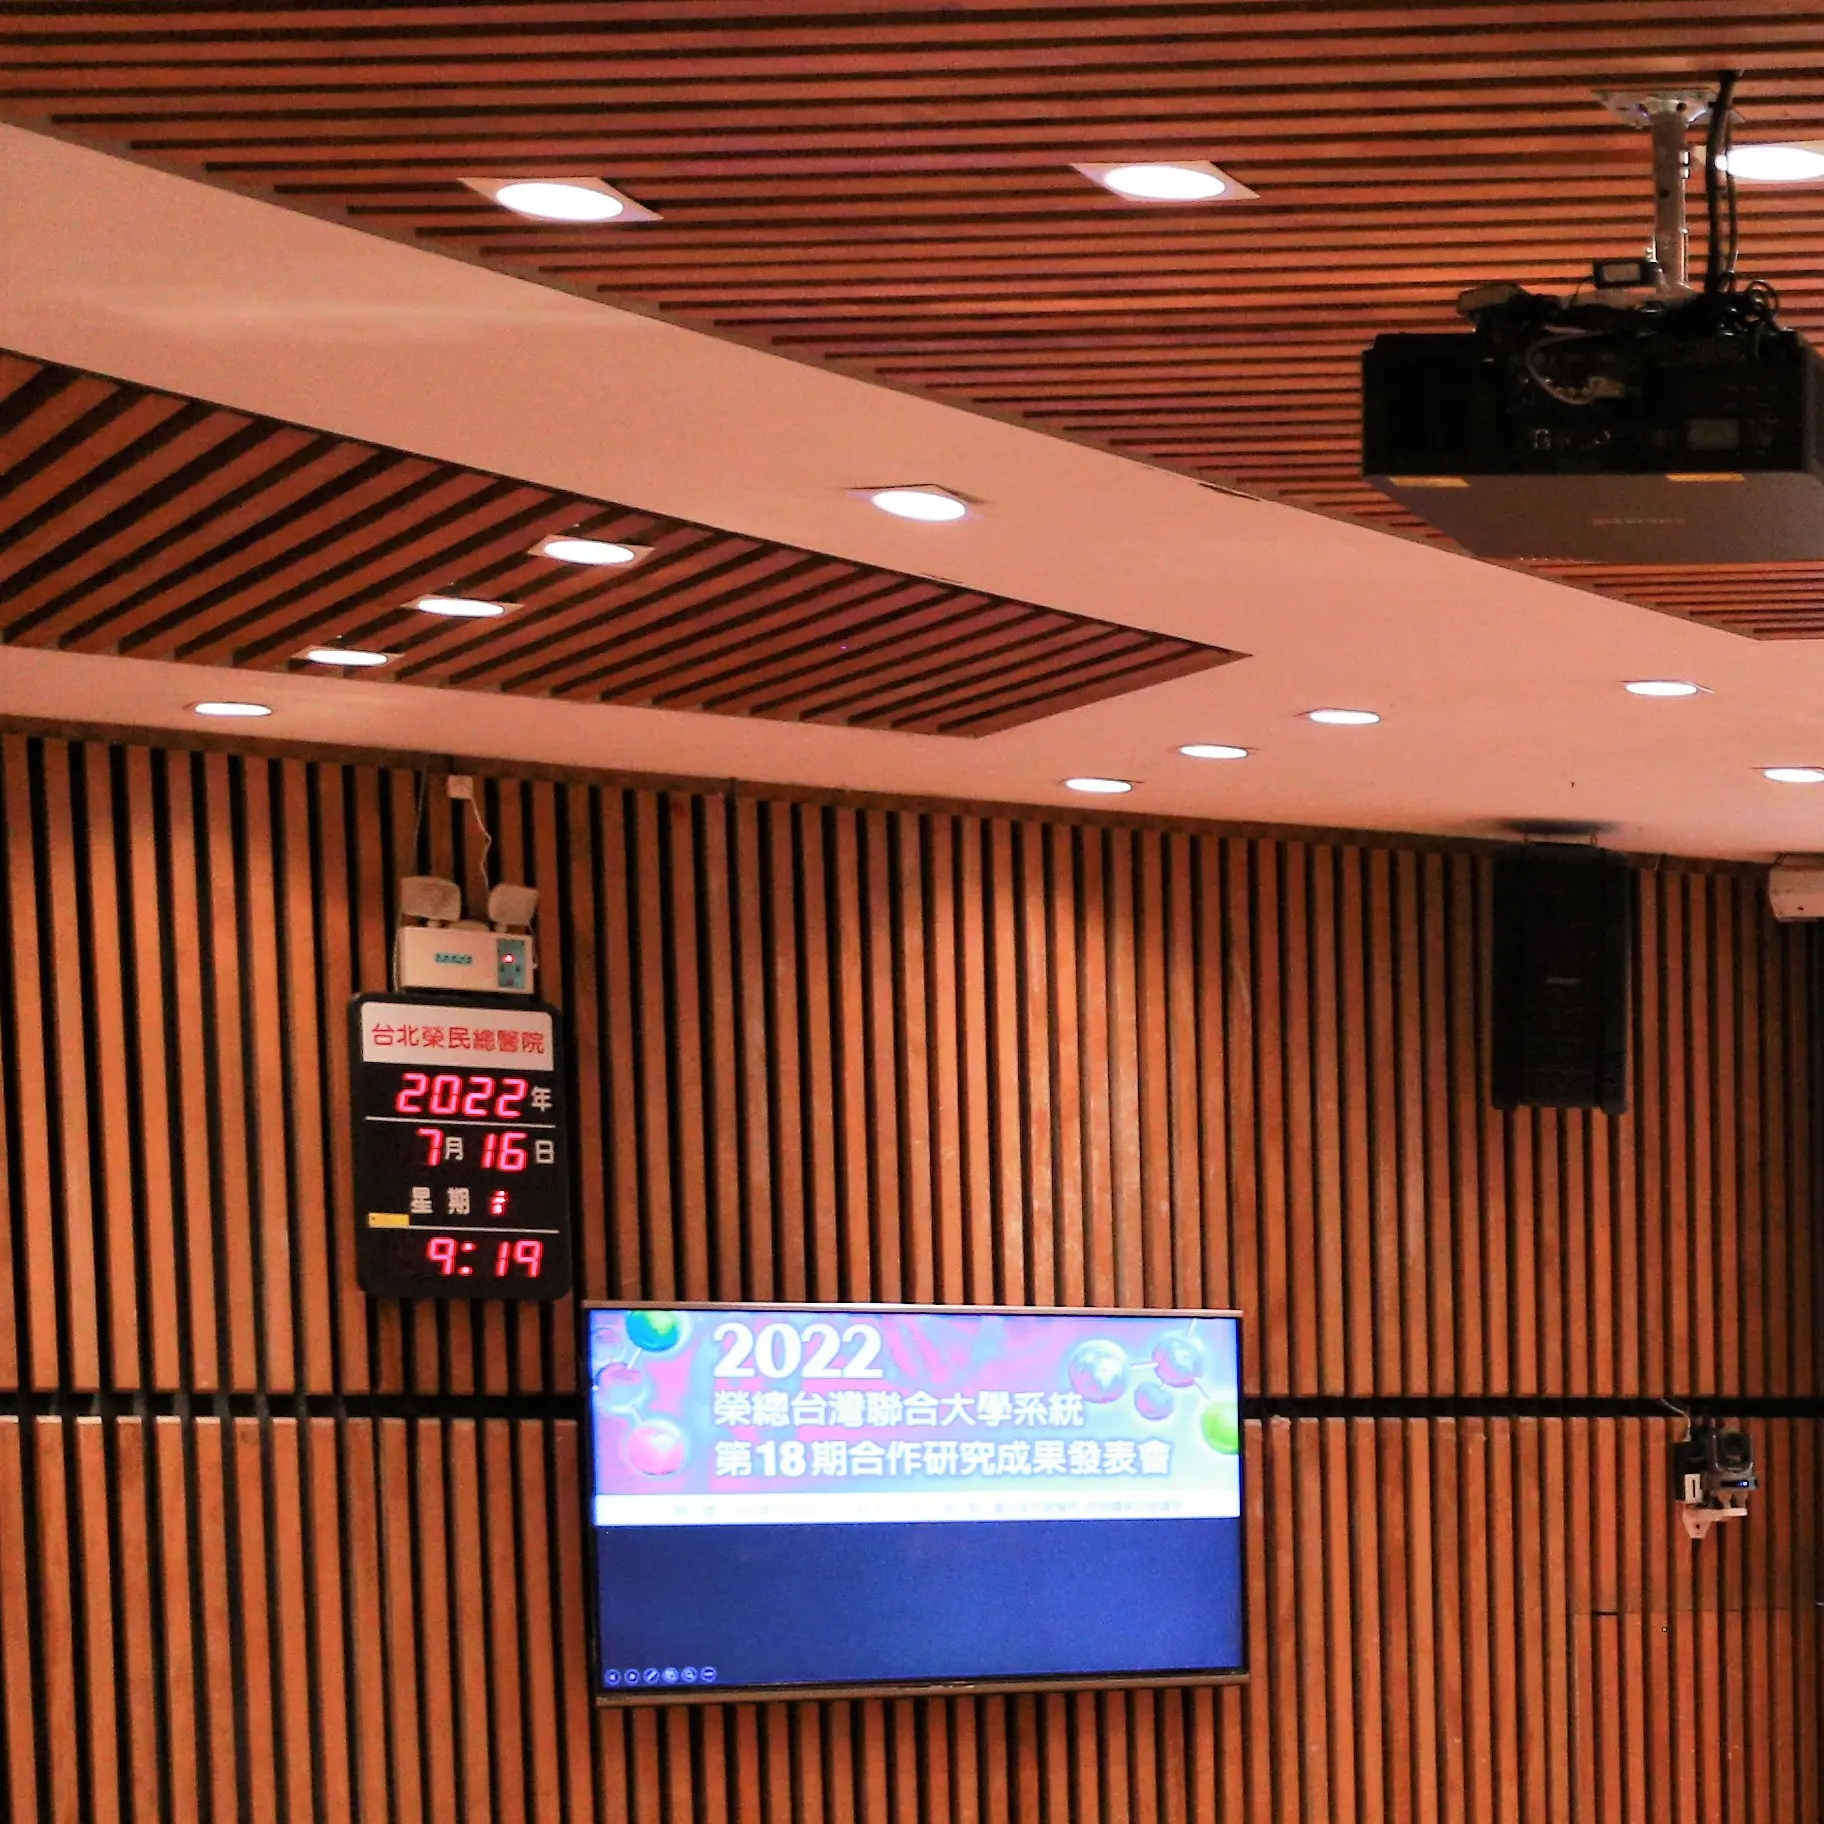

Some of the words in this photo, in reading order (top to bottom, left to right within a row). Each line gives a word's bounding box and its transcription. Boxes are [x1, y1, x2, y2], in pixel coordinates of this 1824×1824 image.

[372, 1022, 545, 1054] 台北榮民總醫院
[426, 1237, 544, 1278] 9:19
[713, 1322, 884, 1379] 2022
[713, 1390, 1084, 1428] 榮總台灣聯合大學系統
[714, 1439, 1172, 1477] 第18期合作研究成果發表會
